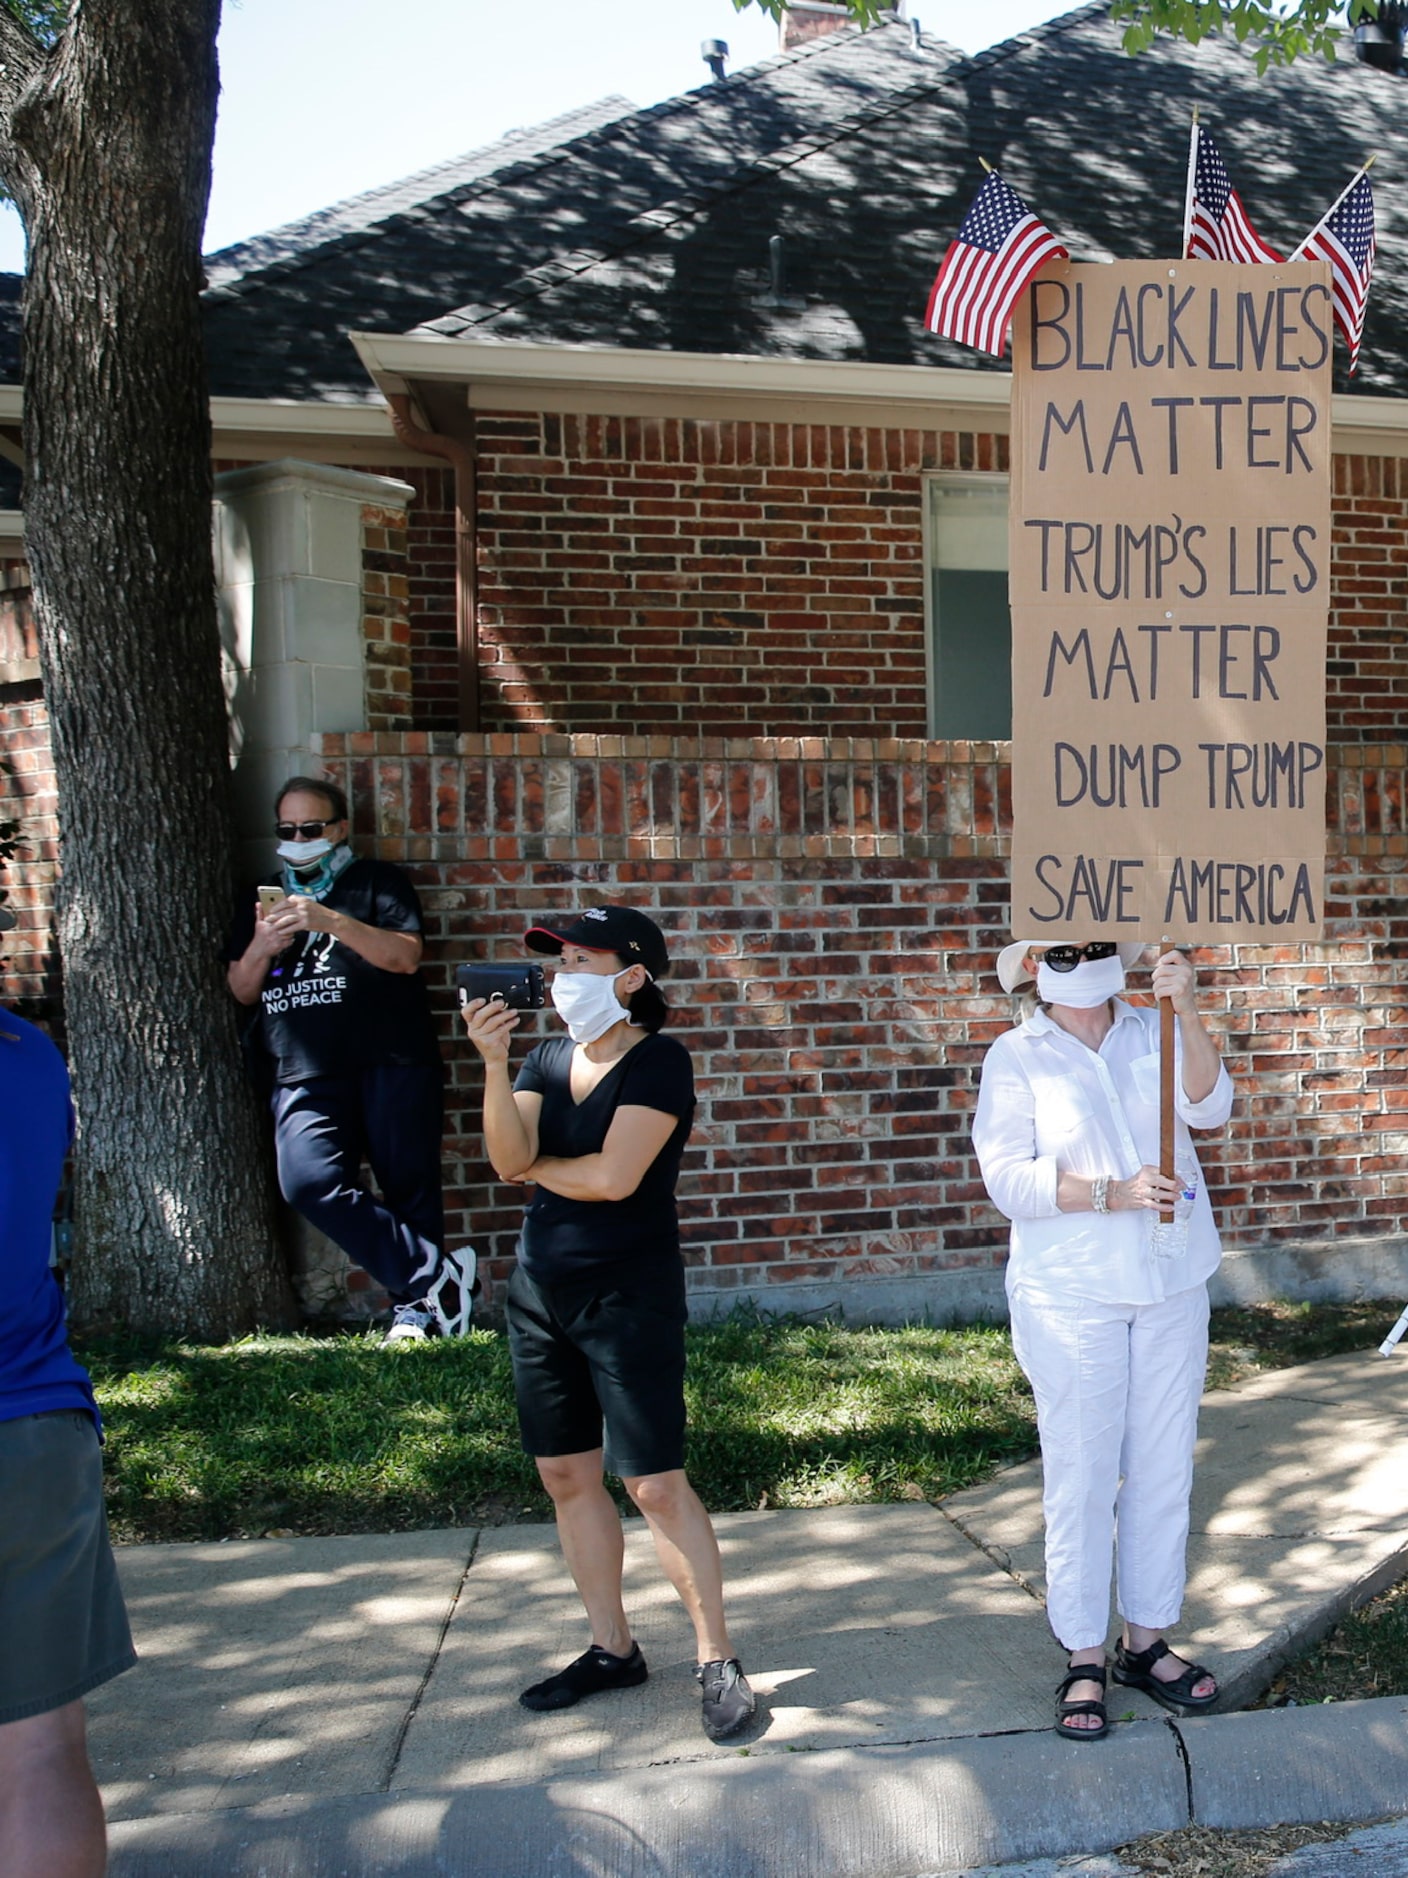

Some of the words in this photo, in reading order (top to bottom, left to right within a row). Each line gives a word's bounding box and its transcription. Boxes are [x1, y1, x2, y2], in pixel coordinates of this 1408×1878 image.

[1030, 280, 1197, 371] BLACK
[1207, 284, 1330, 372] LIVES
[1038, 395, 1318, 475] MATTER
[1024, 513, 1207, 600] TRUMP'S
[1229, 524, 1318, 596] LIES
[1043, 624, 1281, 703] MATTER
[1054, 741, 1182, 808] DUMP
[1198, 741, 1324, 809] TRUMP
[1029, 854, 1144, 922] SAVE
[1164, 856, 1316, 925] AMERICA
[261, 987, 283, 1003] NO
[285, 976, 347, 997] JUSTICE
[266, 999, 289, 1015] NO
[291, 990, 343, 1009] PEACE
